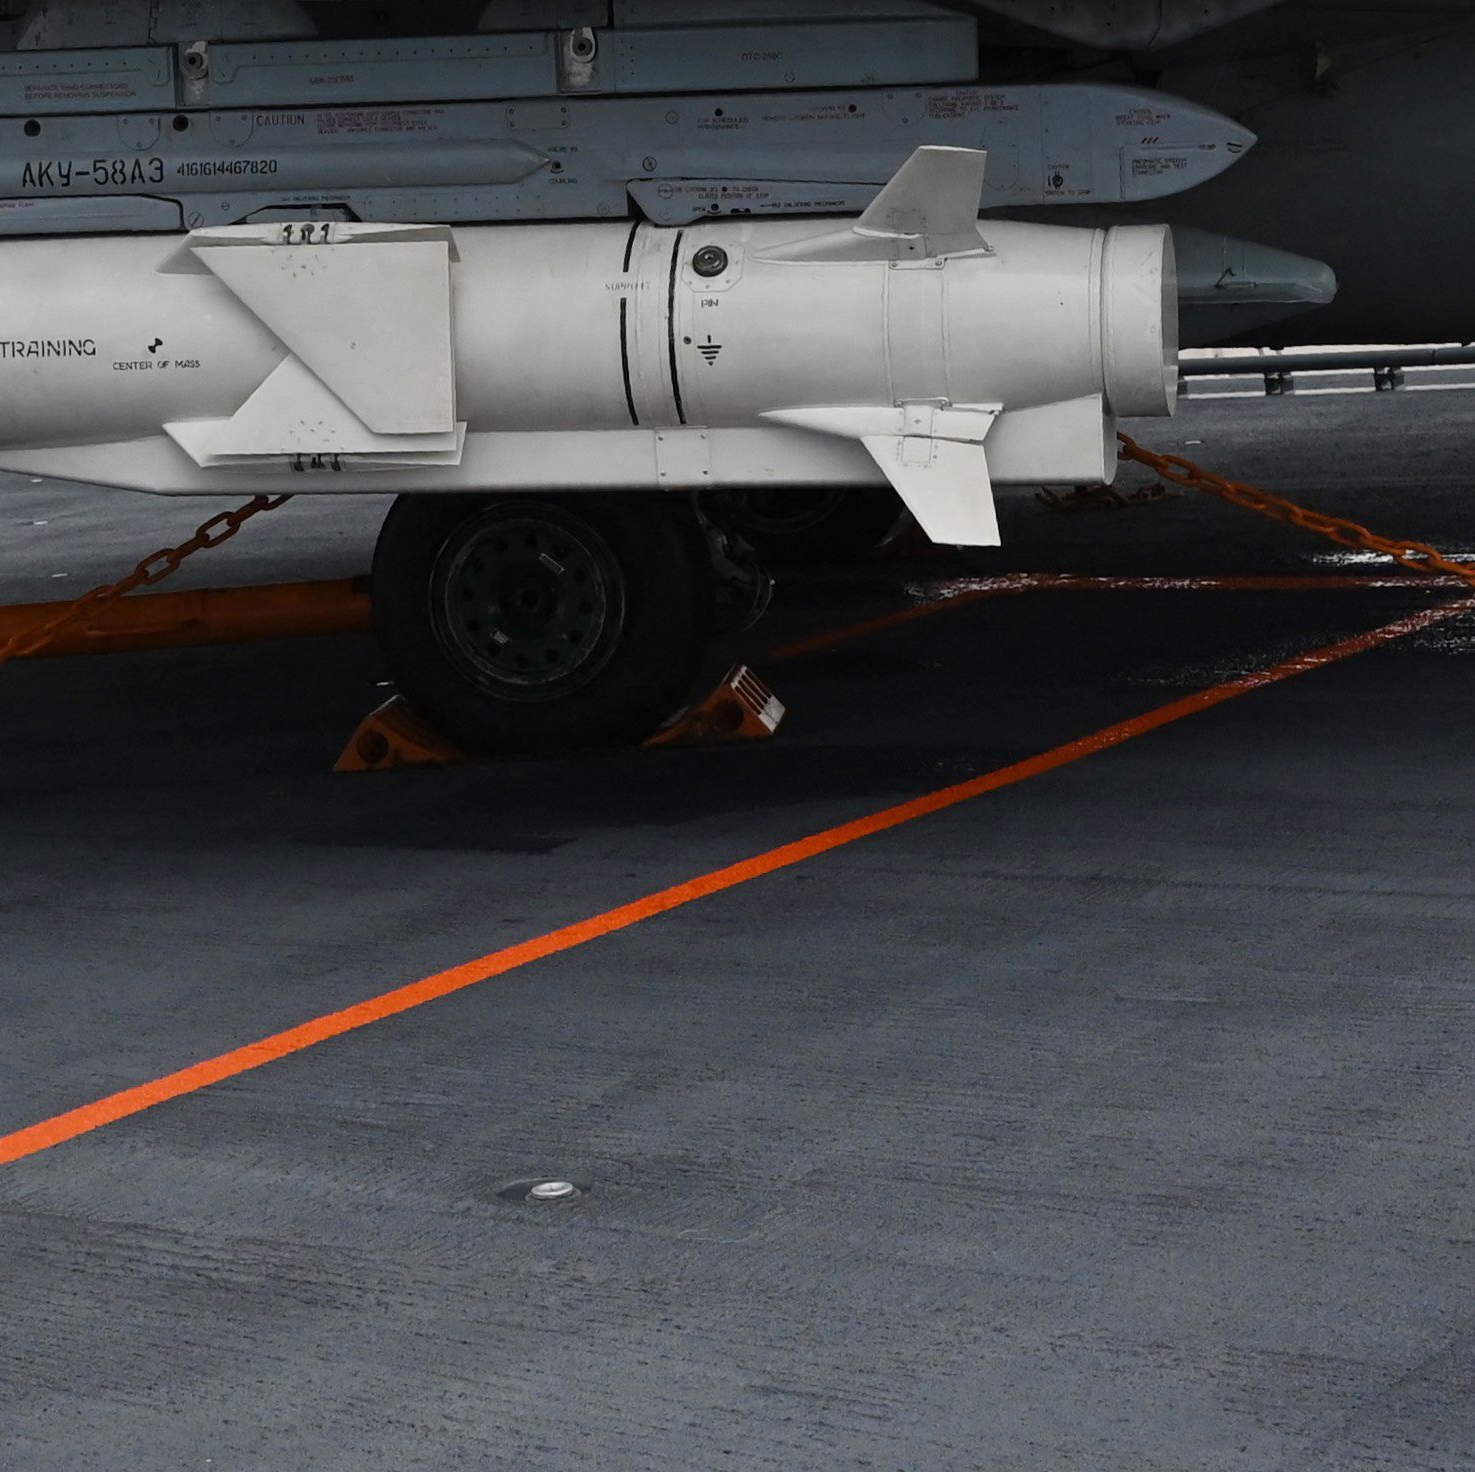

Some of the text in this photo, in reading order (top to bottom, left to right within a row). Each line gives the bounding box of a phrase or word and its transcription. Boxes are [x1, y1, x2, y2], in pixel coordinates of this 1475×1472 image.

[113, 359, 201, 371] CENTER OF MASS
